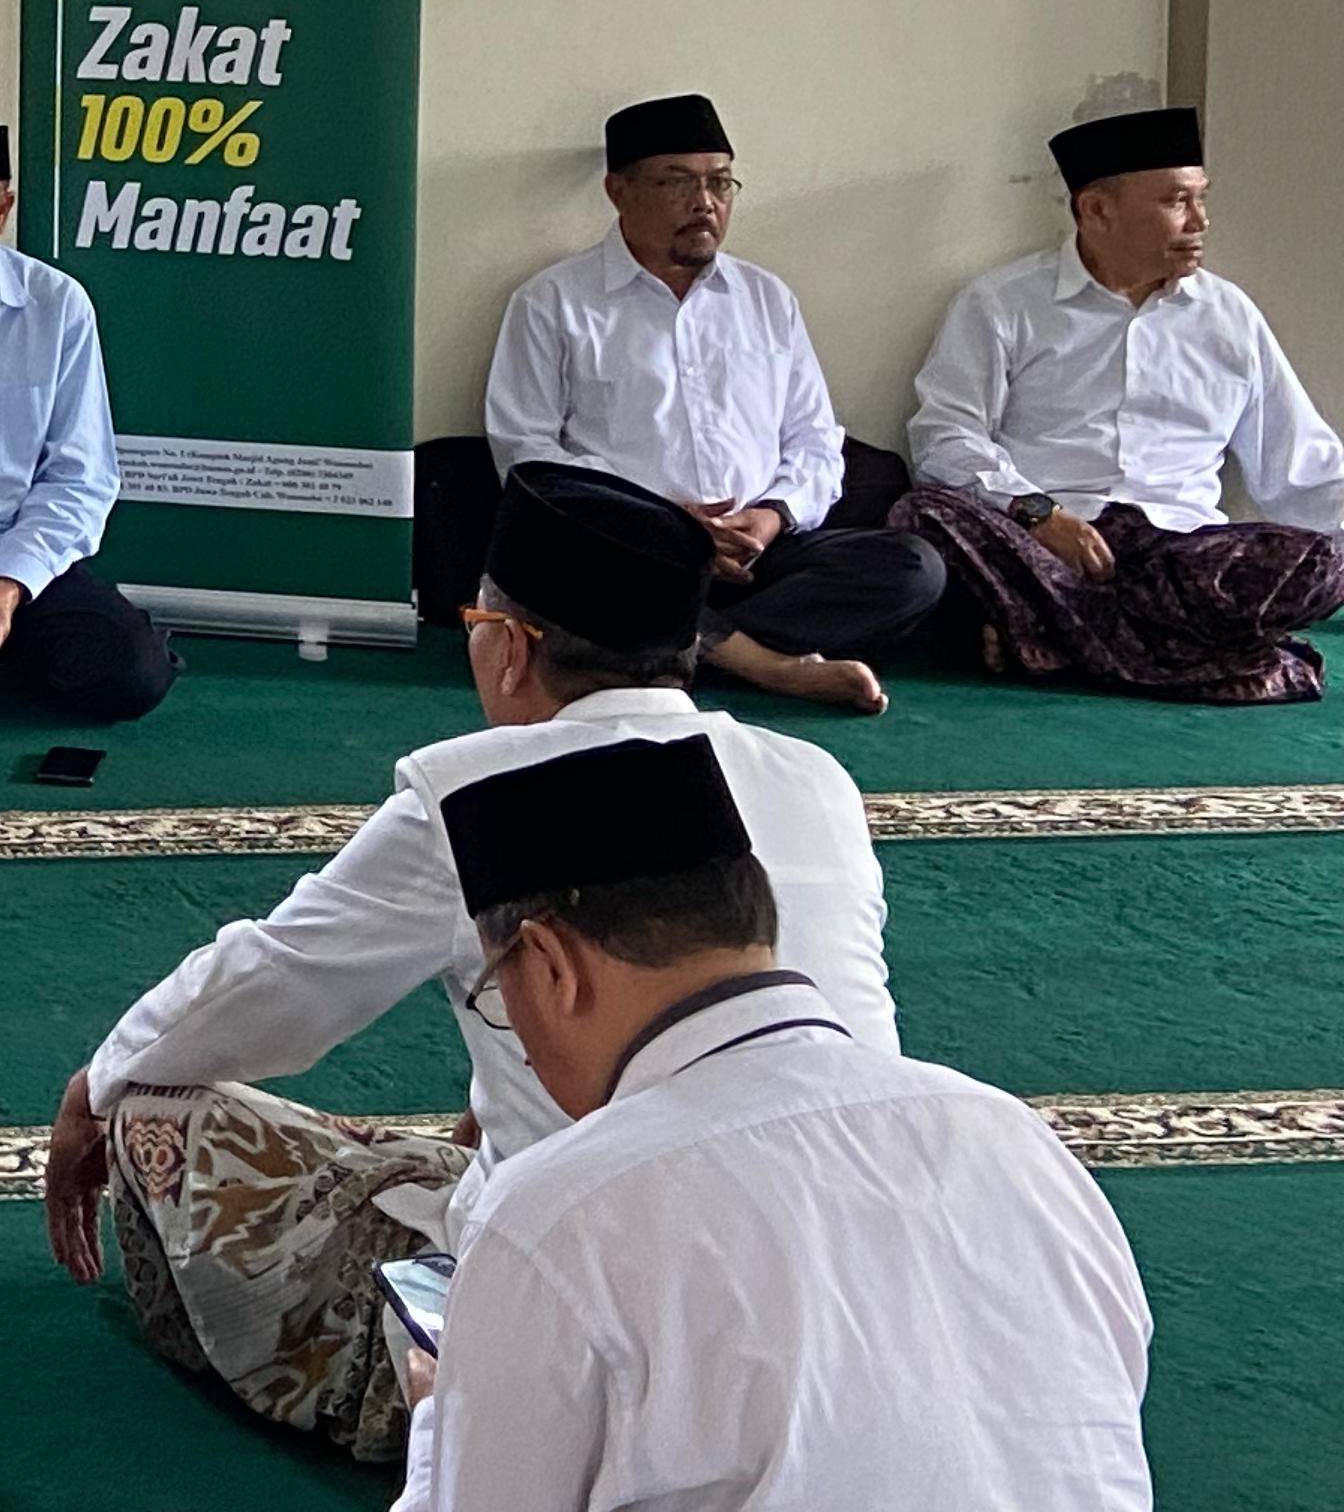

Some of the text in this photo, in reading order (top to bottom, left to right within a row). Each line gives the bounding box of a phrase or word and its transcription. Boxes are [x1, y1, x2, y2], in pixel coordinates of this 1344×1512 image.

[76, 6, 292, 86] Zakat
[77, 94, 263, 167] 100%
[75, 180, 362, 261] Manfaat
